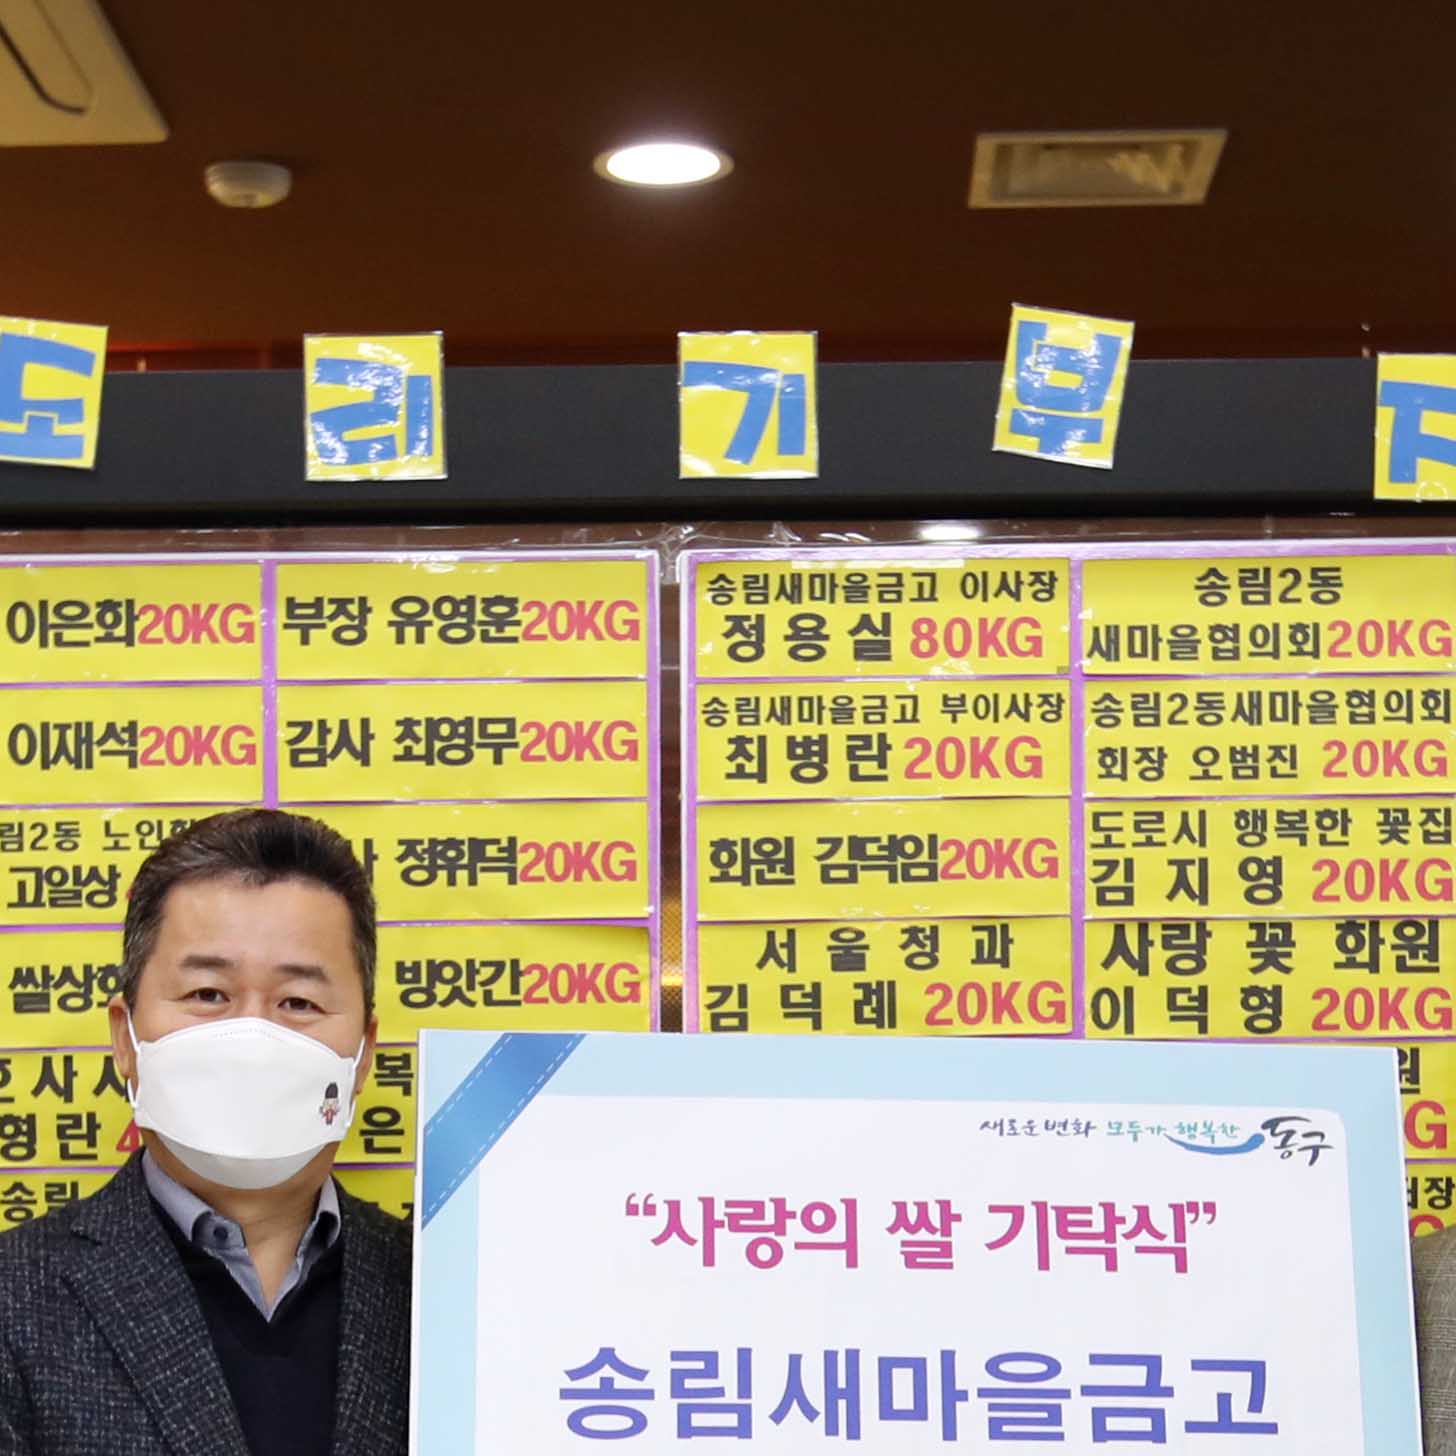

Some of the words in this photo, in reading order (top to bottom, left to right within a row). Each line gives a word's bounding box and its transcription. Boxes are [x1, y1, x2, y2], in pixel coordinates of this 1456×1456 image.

[707, 572, 939, 606] 송림새마을금고
[959, 570, 1059, 603] 이사장
[1194, 565, 1344, 607] 송림2동
[282, 596, 372, 646] 부장
[909, 616, 1043, 659] 80KG
[701, 694, 921, 728] 송림새마을금고
[940, 692, 1066, 724] 부이사장
[285, 717, 375, 768] 감사
[903, 735, 1043, 780] 20KG
[1097, 746, 1168, 782] 회장
[1189, 744, 1298, 781] 오범진
[1322, 738, 1449, 779] 20KG
[1090, 808, 1208, 849] 도로시
[1234, 808, 1352, 848] 행복한
[1375, 807, 1453, 846] 꽃집
[7, 864, 121, 909] 고일상
[1311, 858, 1454, 903] 20KG
[1100, 920, 1212, 977] 사랑
[1245, 921, 1296, 975] 꽃
[1334, 918, 1440, 974] 화원
[924, 980, 1067, 1026] 20KG
[1311, 986, 1454, 1032] 20KG
[1107, 1119, 1166, 1143] 모두가
[625, 1193, 859, 1270] “사랑의
[885, 1199, 963, 1271] 쌀
[984, 1200, 1218, 1274] 기탁식”
[558, 1346, 1280, 1444] 송림새마을금고
